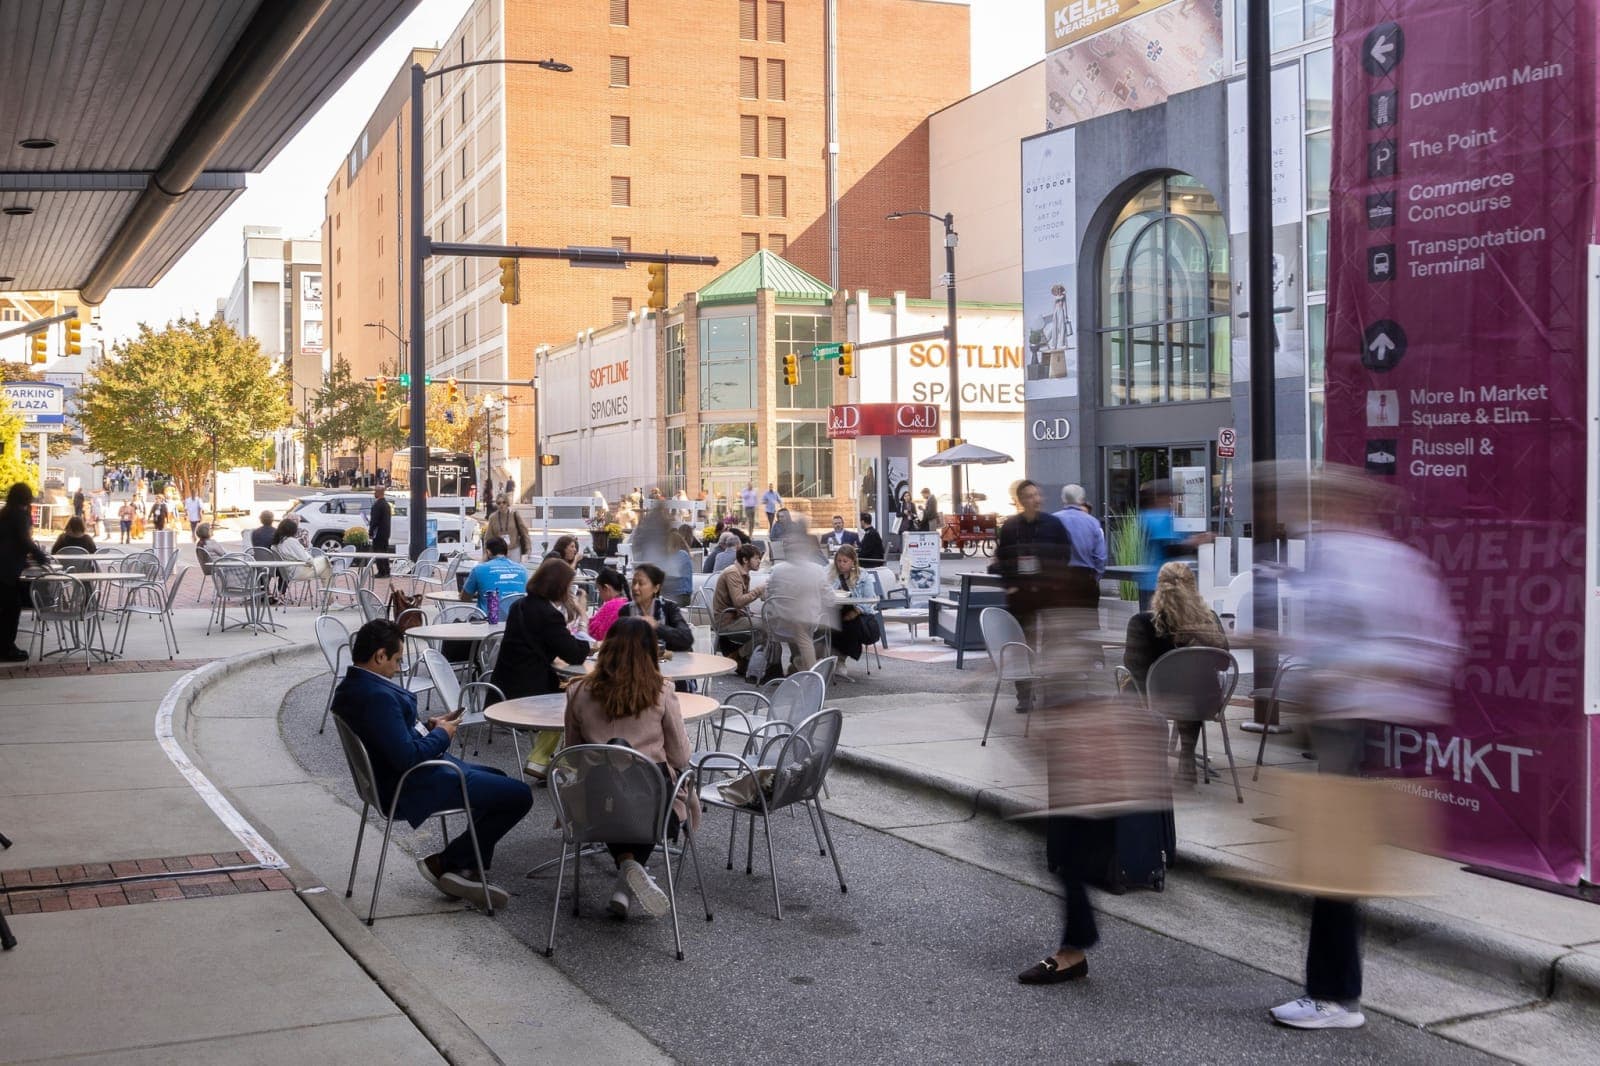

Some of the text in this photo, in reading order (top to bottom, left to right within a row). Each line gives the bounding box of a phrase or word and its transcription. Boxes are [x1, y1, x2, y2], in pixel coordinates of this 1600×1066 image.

[1054, 0, 1117, 29] KELL
[1055, 4, 1120, 38] WEARSTLER
[1409, 62, 1563, 109] Downtown Main
[1409, 127, 1498, 159] The Point
[1026, 178, 1072, 194] OUTDOOR
[1408, 172, 1515, 201] Commerce
[1408, 195, 1512, 222] Concourse
[1408, 227, 1546, 256] Transportation
[1408, 253, 1485, 277] Terminal
[909, 343, 1024, 369] SOTLIN
[589, 359, 629, 390] SOFTLINE
[1410, 384, 1549, 405] More In Market
[591, 395, 628, 420] SPAGNES
[896, 404, 937, 428] C&D
[1412, 408, 1529, 429] Square & Elm
[1032, 418, 1070, 441] C&D
[1411, 438, 1494, 455] Russell &
[1410, 460, 1467, 477] Green
